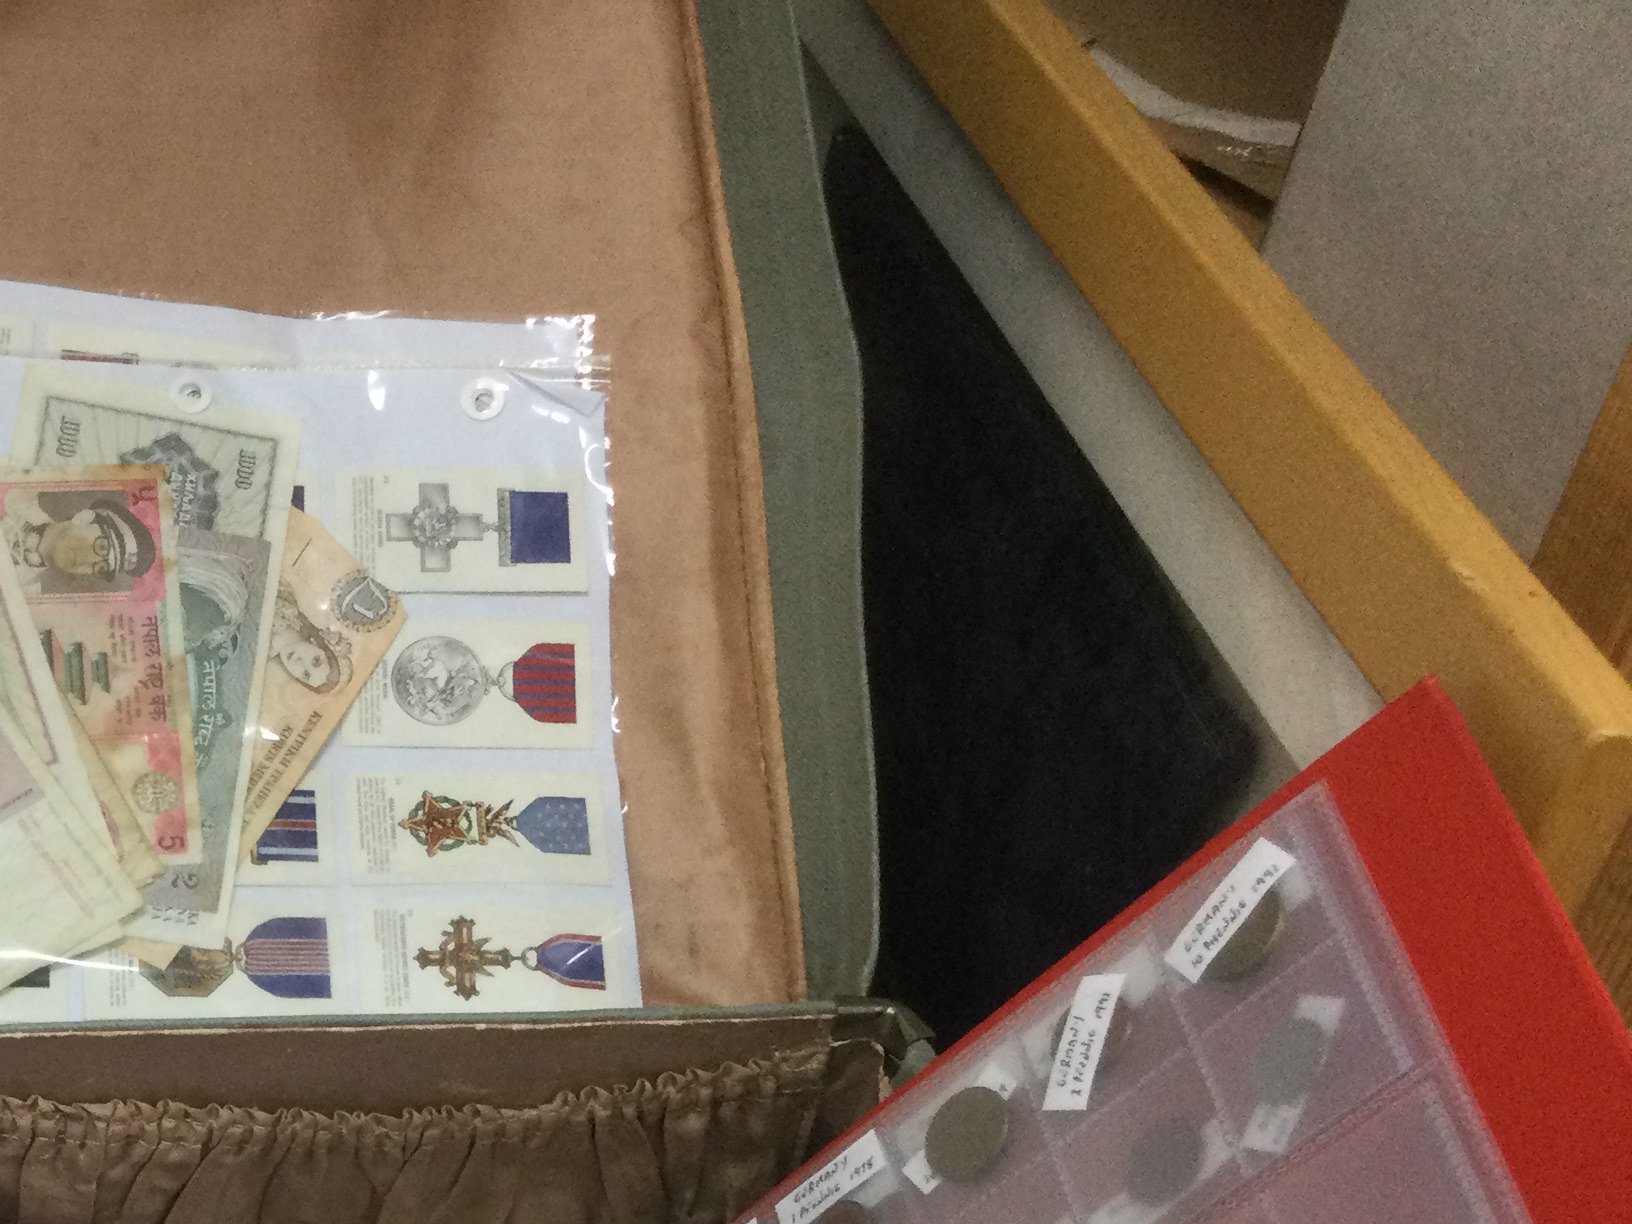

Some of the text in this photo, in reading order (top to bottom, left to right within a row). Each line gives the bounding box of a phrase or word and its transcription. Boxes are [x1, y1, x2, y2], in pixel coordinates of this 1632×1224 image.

[234, 447, 257, 491] 1000
[157, 834, 184, 850] 5
[792, 1157, 850, 1202] GERMANY
